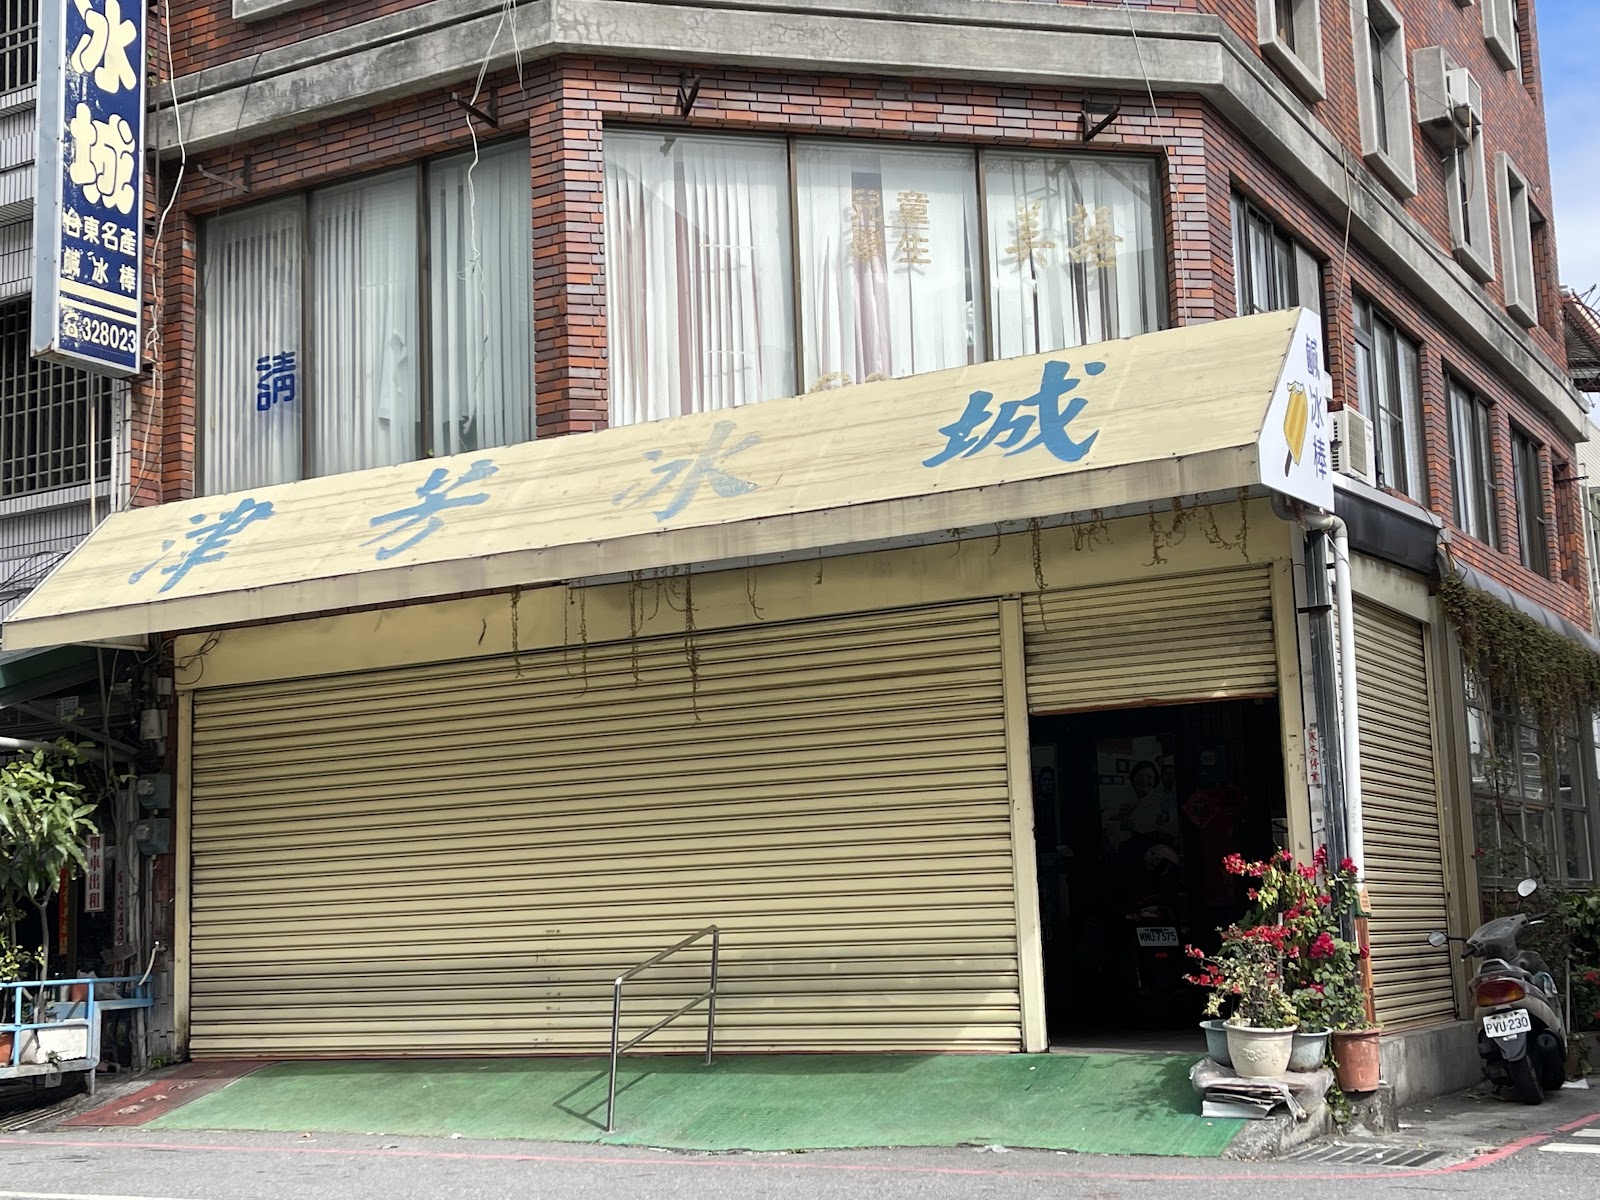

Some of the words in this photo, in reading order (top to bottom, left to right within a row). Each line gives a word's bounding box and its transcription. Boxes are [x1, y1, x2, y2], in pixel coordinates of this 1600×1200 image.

[70, 0, 138, 215] 冰城
[62, 206, 137, 257] 台東名產
[82, 316, 137, 354] 328023
[256, 351, 297, 412] 請
[1305, 333, 1328, 480] 鹹冰棒
[127, 359, 1107, 594] 津芳冰城
